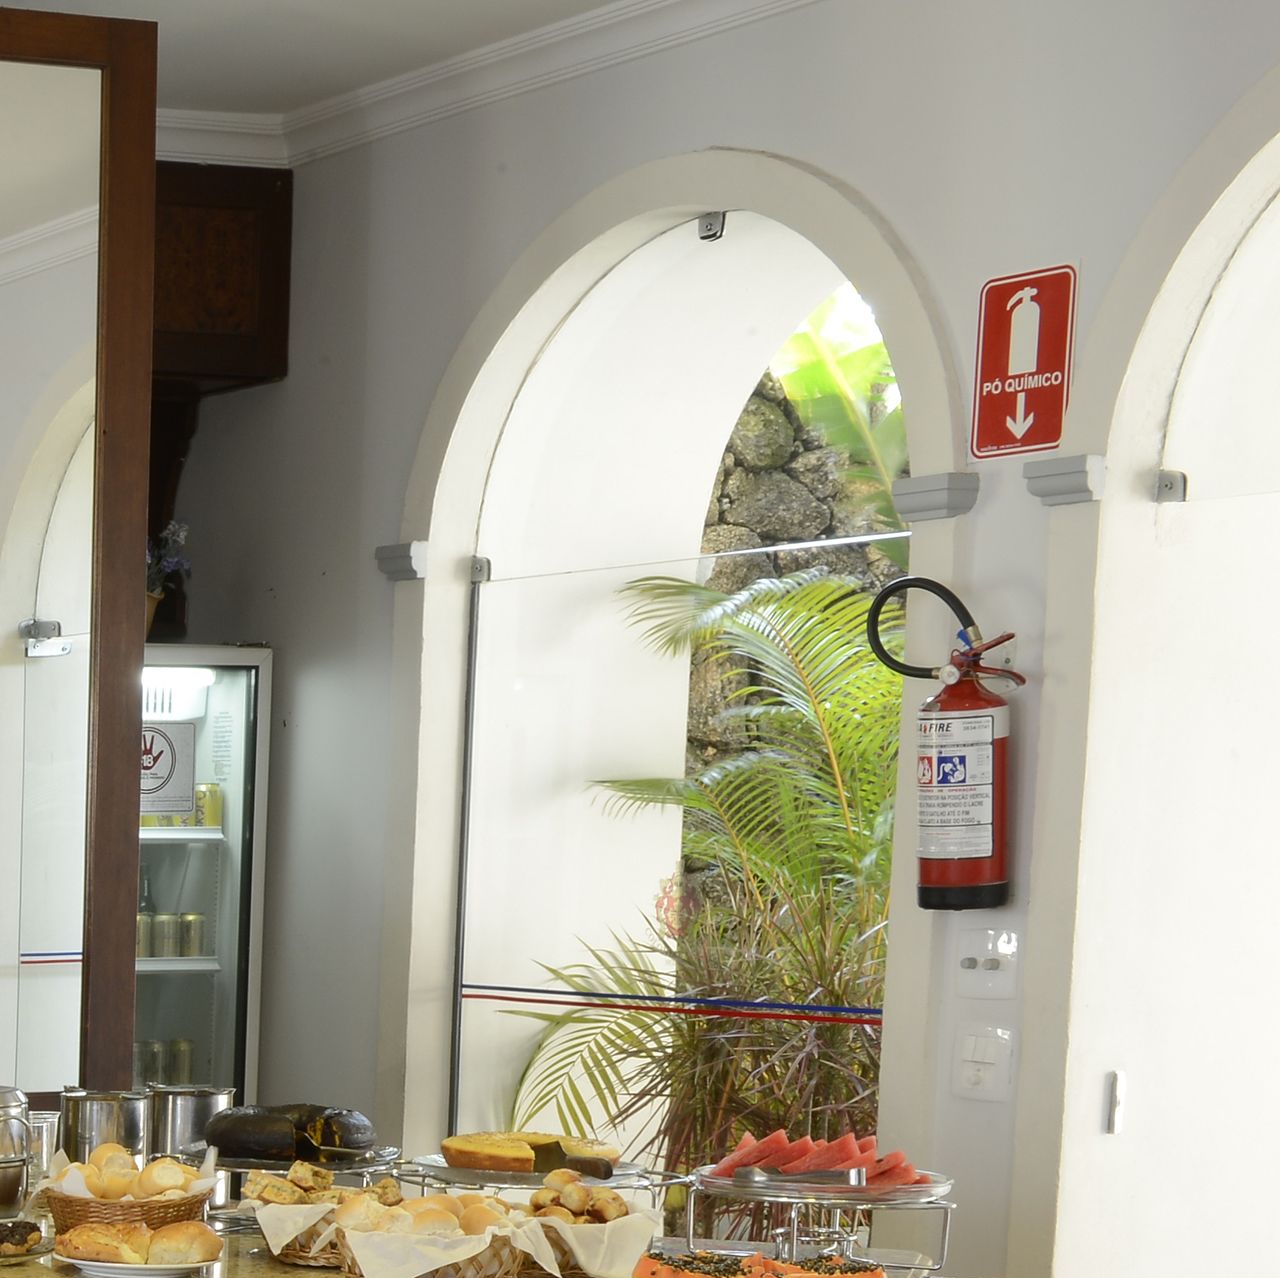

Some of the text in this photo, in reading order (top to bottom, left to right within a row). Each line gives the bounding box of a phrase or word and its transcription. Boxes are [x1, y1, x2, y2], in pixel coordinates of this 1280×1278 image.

[983, 371, 1062, 396] PÓ QUÍMICO
[929, 722, 953, 732] FIRE
